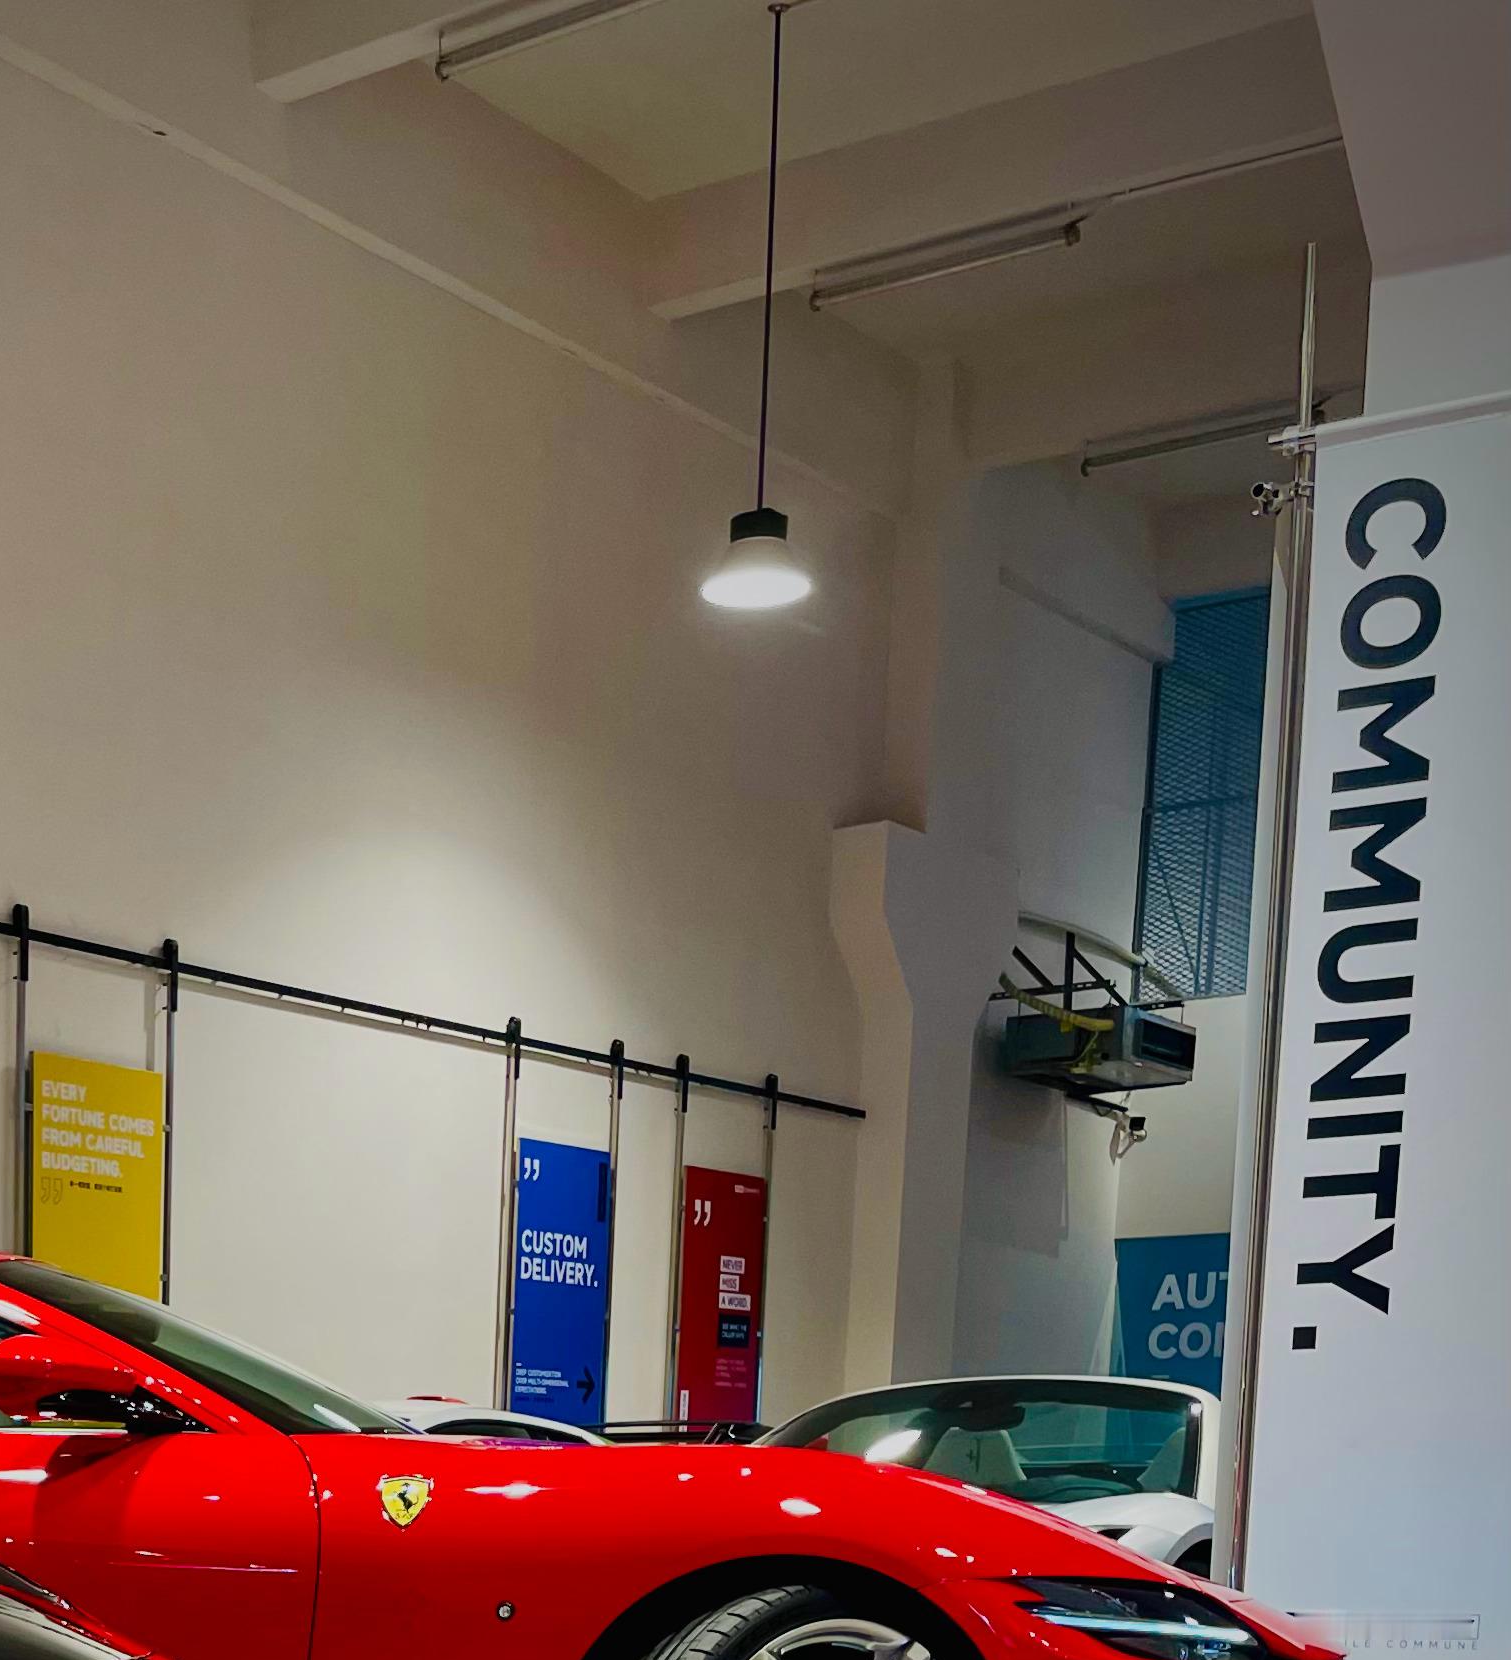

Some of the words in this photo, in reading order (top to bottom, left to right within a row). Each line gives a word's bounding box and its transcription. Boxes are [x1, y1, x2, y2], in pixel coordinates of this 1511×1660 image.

[1292, 478, 1446, 1349] COMMUNITY.
[41, 1079, 87, 1102] EVERY
[41, 1103, 105, 1129] FORTUNE
[109, 1114, 154, 1136] COMES
[41, 1127, 82, 1147] FROM
[86, 1133, 145, 1158] CAREFUL
[41, 1151, 123, 1178] BUDGETING.
[521, 1229, 587, 1259] CUSTOM
[520, 1256, 598, 1287] DELIVERY.
[722, 1258, 743, 1272] NEVER
[1386, 1639, 1478, 1650] COMMUNE
